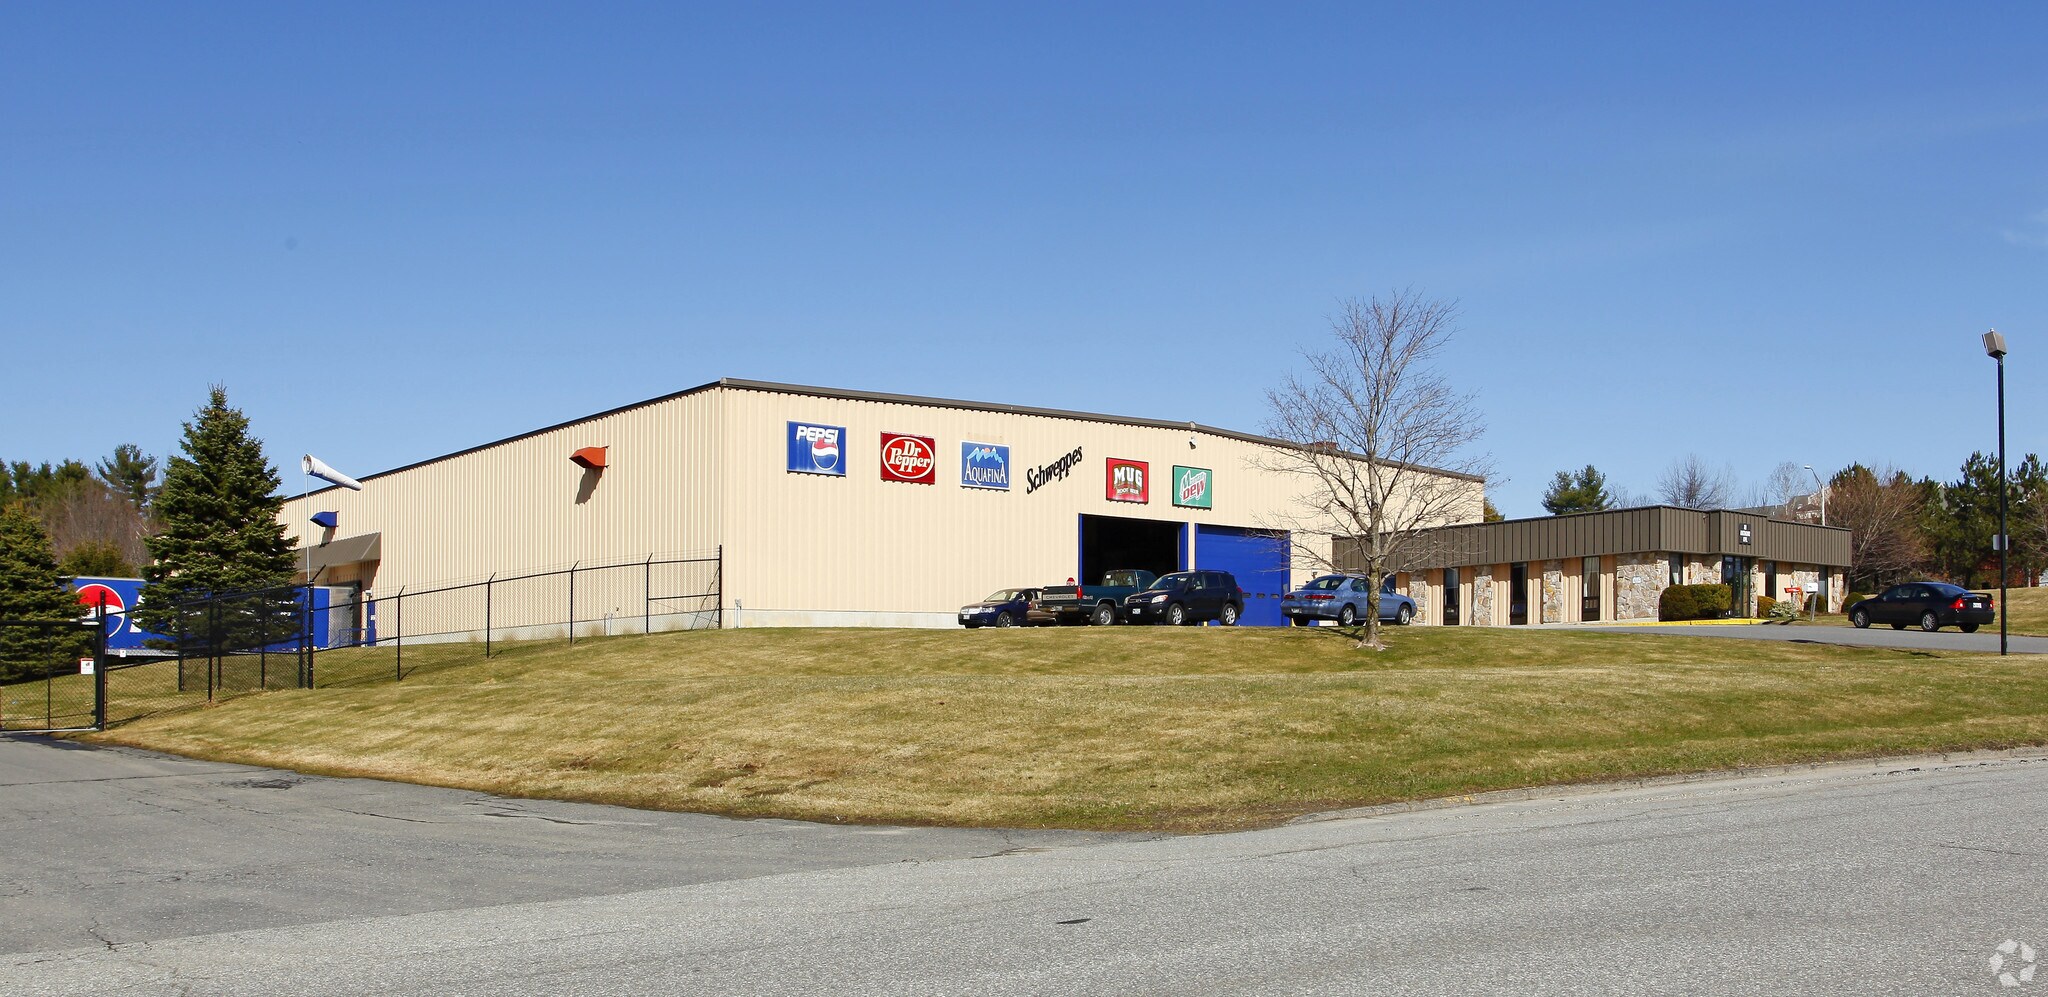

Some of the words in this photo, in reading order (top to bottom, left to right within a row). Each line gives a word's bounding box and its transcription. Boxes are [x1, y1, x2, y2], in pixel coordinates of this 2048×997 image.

[796, 426, 839, 443] PEPSI
[888, 447, 930, 472] Pepper
[902, 441, 922, 457] Dr
[1026, 446, 1082, 494] Schweppes
[1114, 466, 1142, 488] MUG
